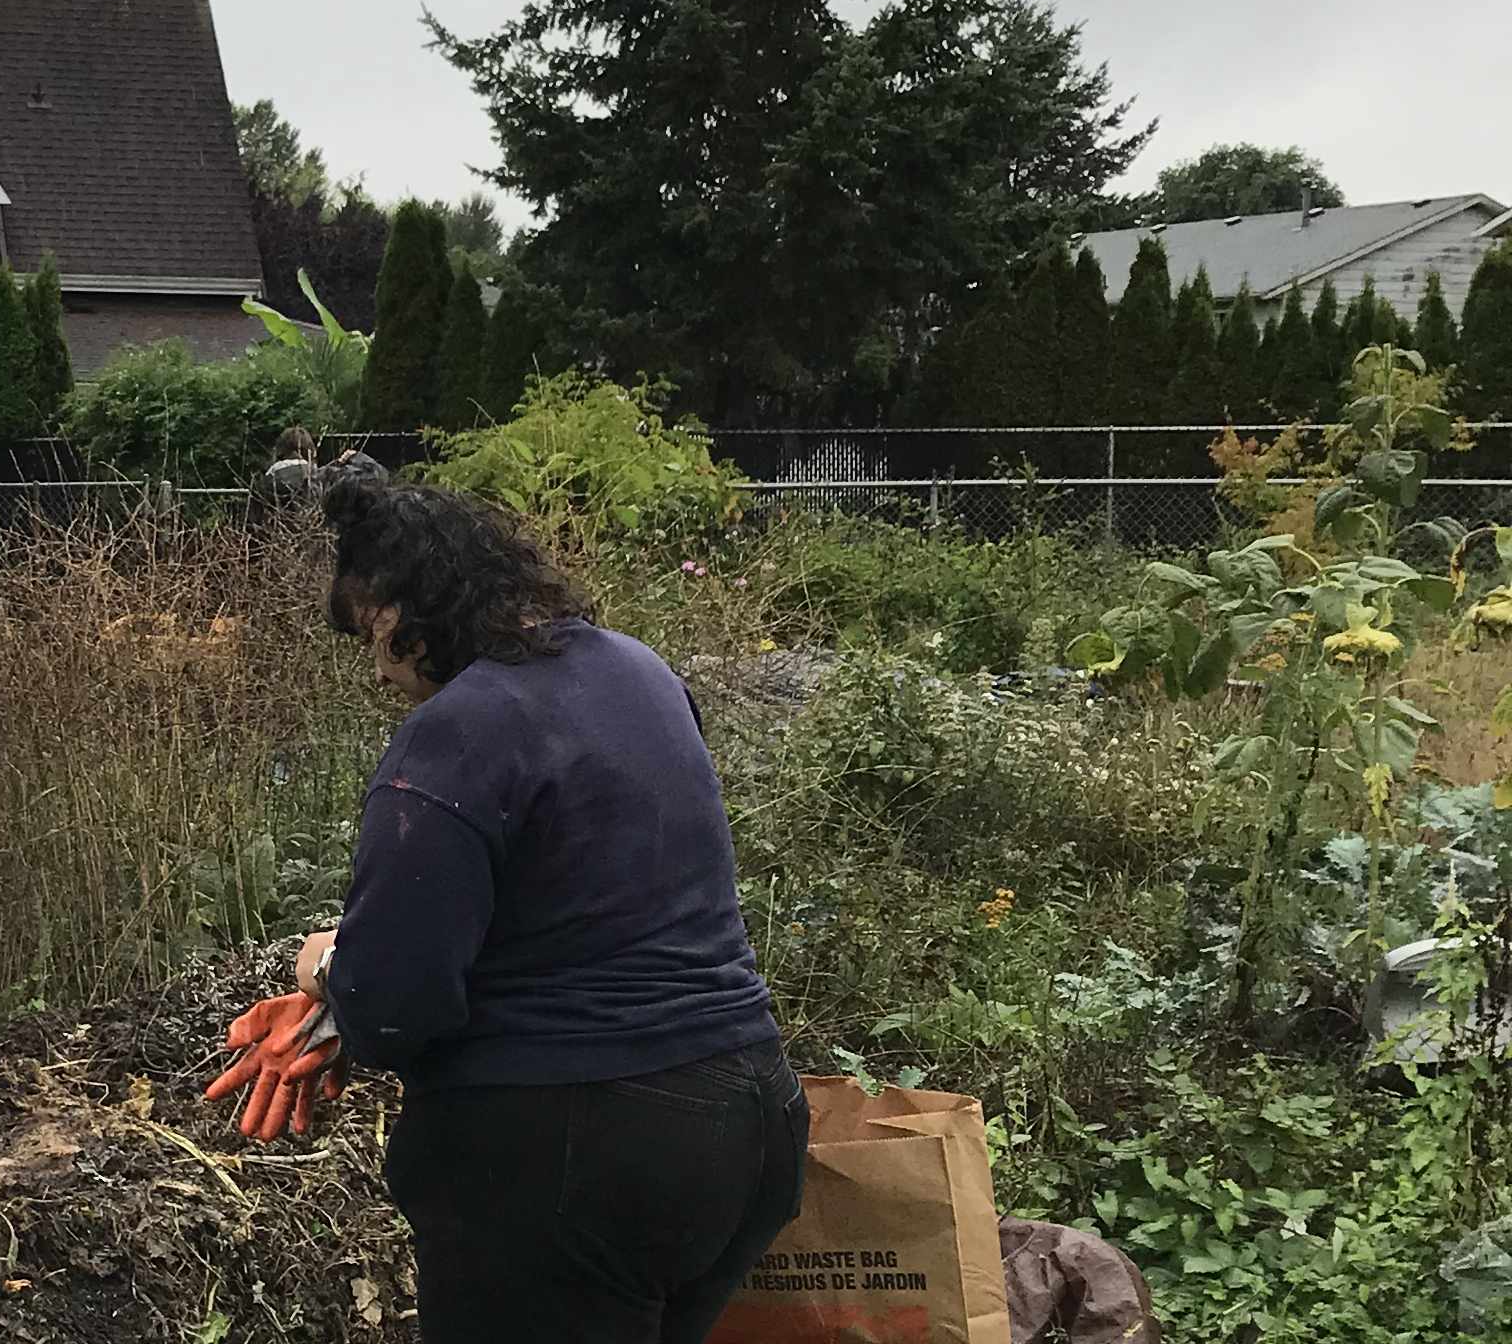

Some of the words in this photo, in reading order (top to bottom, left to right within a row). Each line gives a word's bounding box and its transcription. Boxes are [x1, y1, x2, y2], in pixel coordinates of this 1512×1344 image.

[794, 1251, 855, 1269] WASTE
[861, 1250, 898, 1268] BAG
[752, 1270, 826, 1290] RÉSIDUS
[832, 1272, 856, 1290] DE
[861, 1272, 927, 1291] JARDIN
